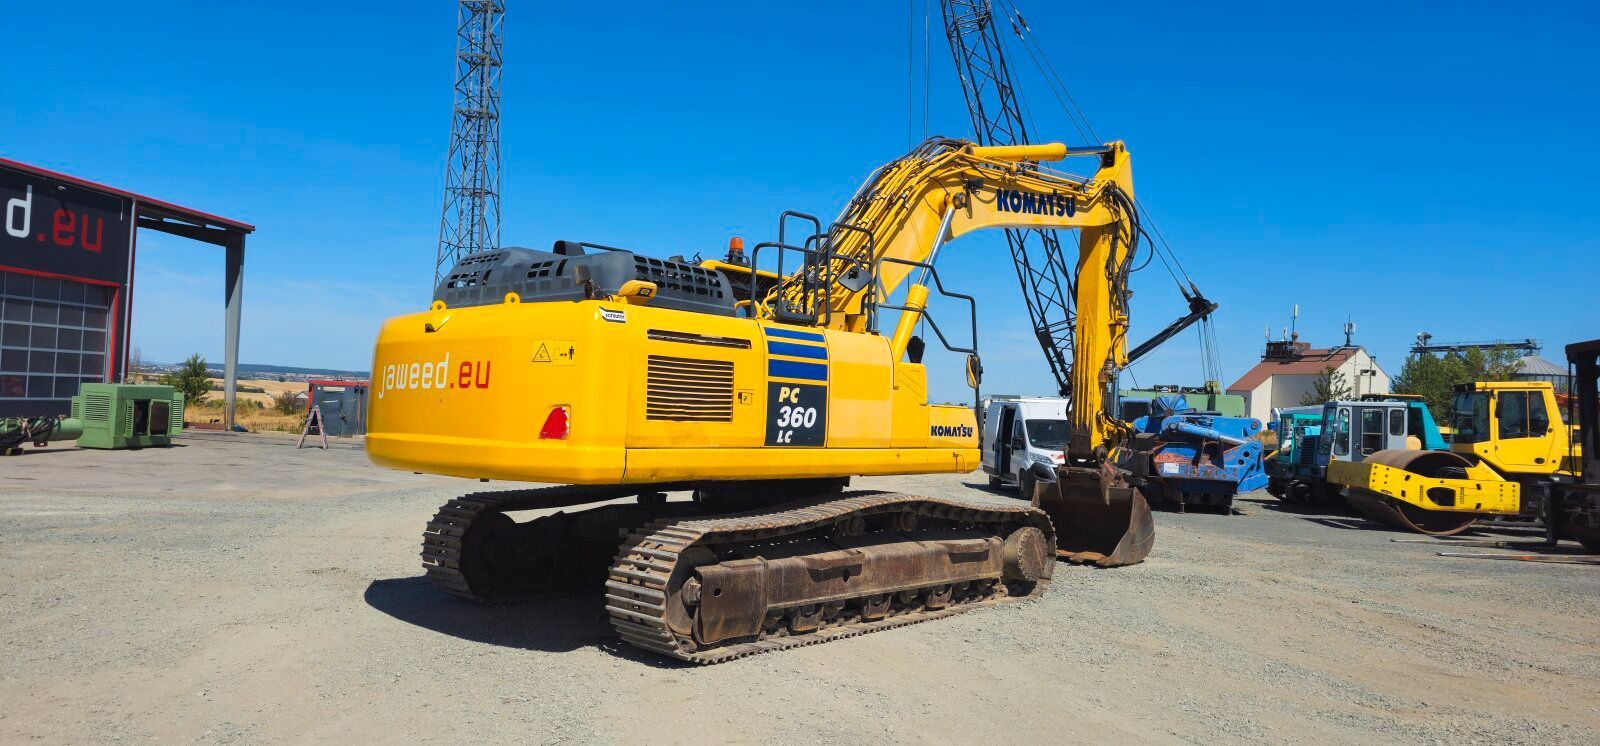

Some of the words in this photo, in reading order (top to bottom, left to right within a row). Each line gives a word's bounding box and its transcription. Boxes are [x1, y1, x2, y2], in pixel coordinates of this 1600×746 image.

[996, 188, 1076, 218] KOMATSU
[378, 352, 491, 399] jaweed.eu
[779, 387, 800, 404] PC
[777, 406, 817, 428] 360
[776, 430, 793, 444] LC
[930, 424, 973, 438] KOMATSU
